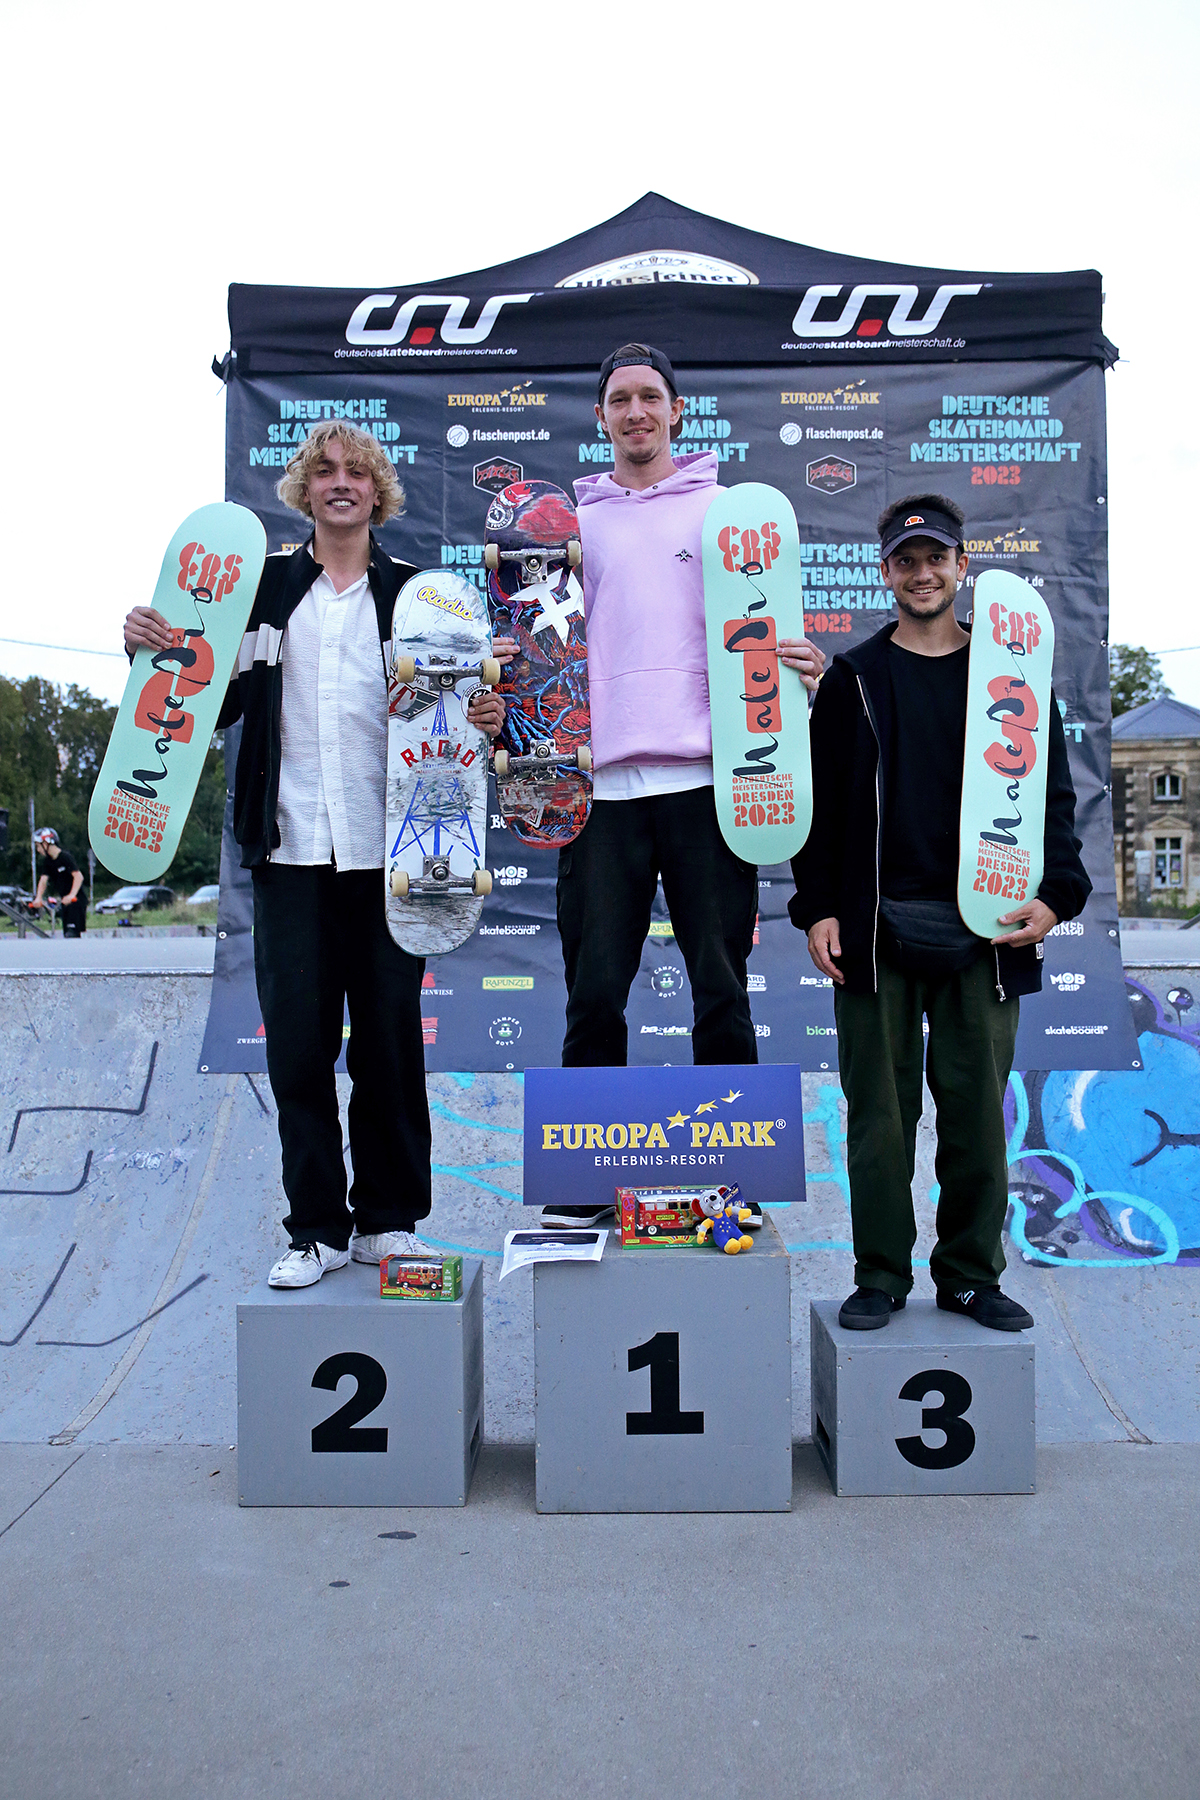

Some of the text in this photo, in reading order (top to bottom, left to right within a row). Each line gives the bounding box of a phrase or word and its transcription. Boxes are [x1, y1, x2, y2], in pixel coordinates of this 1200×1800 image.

[334, 347, 518, 359] deutscheskateboardmeisterschaft.de
[780, 337, 966, 350] deutscheskateboardmeisterschaft.de
[447, 394, 501, 406] EUROPA
[780, 392, 835, 404] EUROPA
[942, 395, 1050, 416] DEUTSCHE
[280, 399, 388, 420] DEUTSCHE
[472, 429, 550, 443] flaschenpost.de
[805, 427, 884, 441] flaschenpost.de
[928, 419, 1064, 439] SKATEBOARD
[910, 442, 1082, 462] MEISTERSCHAFT
[971, 465, 1021, 485] 2023
[800, 543, 881, 563] UTSCHE
[963, 540, 995, 552] ROPA
[801, 566, 886, 587] TEBOAR
[417, 586, 473, 621] Radio
[803, 590, 897, 610] ERSCHAF
[803, 613, 852, 633] 2023
[400, 739, 477, 767] RADIO
[732, 773, 793, 784] OSTDEUTSCHE
[732, 781, 793, 792] MEISTERSCHAFT
[113, 788, 171, 814] OSTDEUTSCHE
[732, 789, 794, 804] DRESDEN
[105, 796, 169, 820] MEISTERSCHAFT
[107, 803, 167, 832] DRESDEN
[733, 802, 796, 827] 2023
[104, 816, 164, 854] 2023
[978, 847, 1031, 866] MEISTERSCHAFT
[979, 839, 1031, 858] OSTDEUTSCHE
[493, 865, 528, 879] MOB
[977, 855, 1031, 878] DRESDEN
[500, 878, 522, 886] GRIP
[972, 868, 1028, 902] 2023
[479, 925, 533, 936] skateboard
[1046, 920, 1085, 937] ONES
[653, 965, 681, 975] CAMPER
[1049, 972, 1086, 985] MOB
[484, 979, 532, 988] RAPUNZEL
[1057, 984, 1080, 992] GRIP
[492, 1017, 520, 1026] CAMPER
[1044, 1025, 1100, 1035] skateboard
[541, 1123, 670, 1150] EUROPA
[594, 1153, 726, 1167] ERLEBNIS-RESORT
[626, 1331, 705, 1436] 1
[310, 1351, 389, 1453] 2
[894, 1368, 977, 1470] 3
